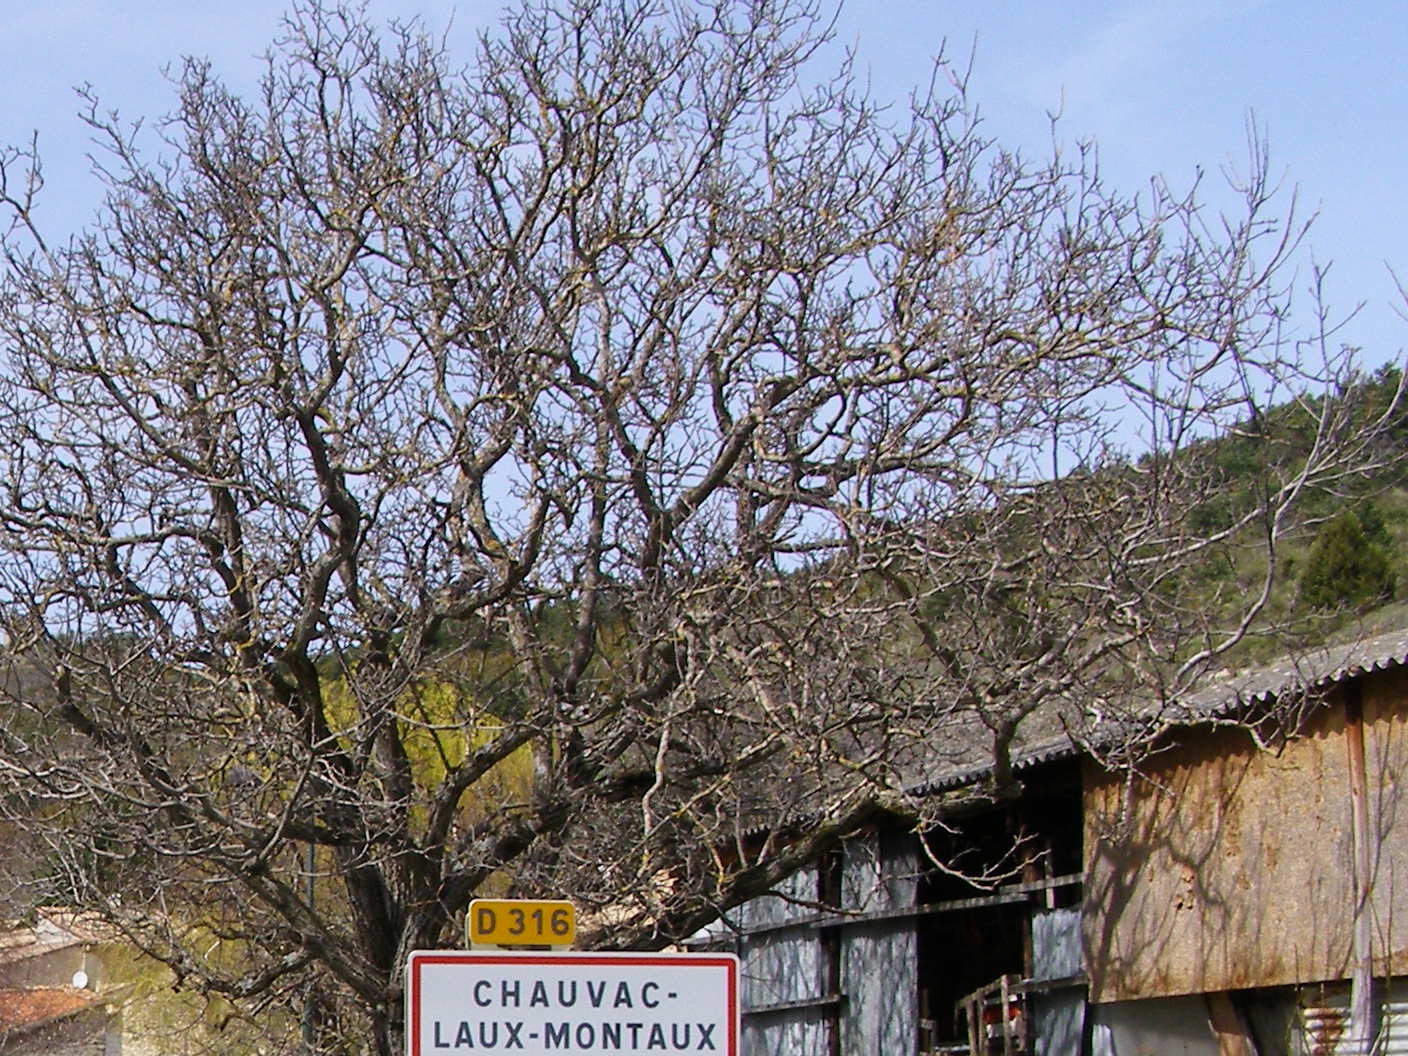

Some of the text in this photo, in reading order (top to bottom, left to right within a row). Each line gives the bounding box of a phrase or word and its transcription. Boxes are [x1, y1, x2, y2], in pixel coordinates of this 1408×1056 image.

[477, 908, 570, 936] D 316
[473, 980, 678, 1009] CHAUVAC-
[433, 1021, 717, 1051] LAUX-MONTAUX
